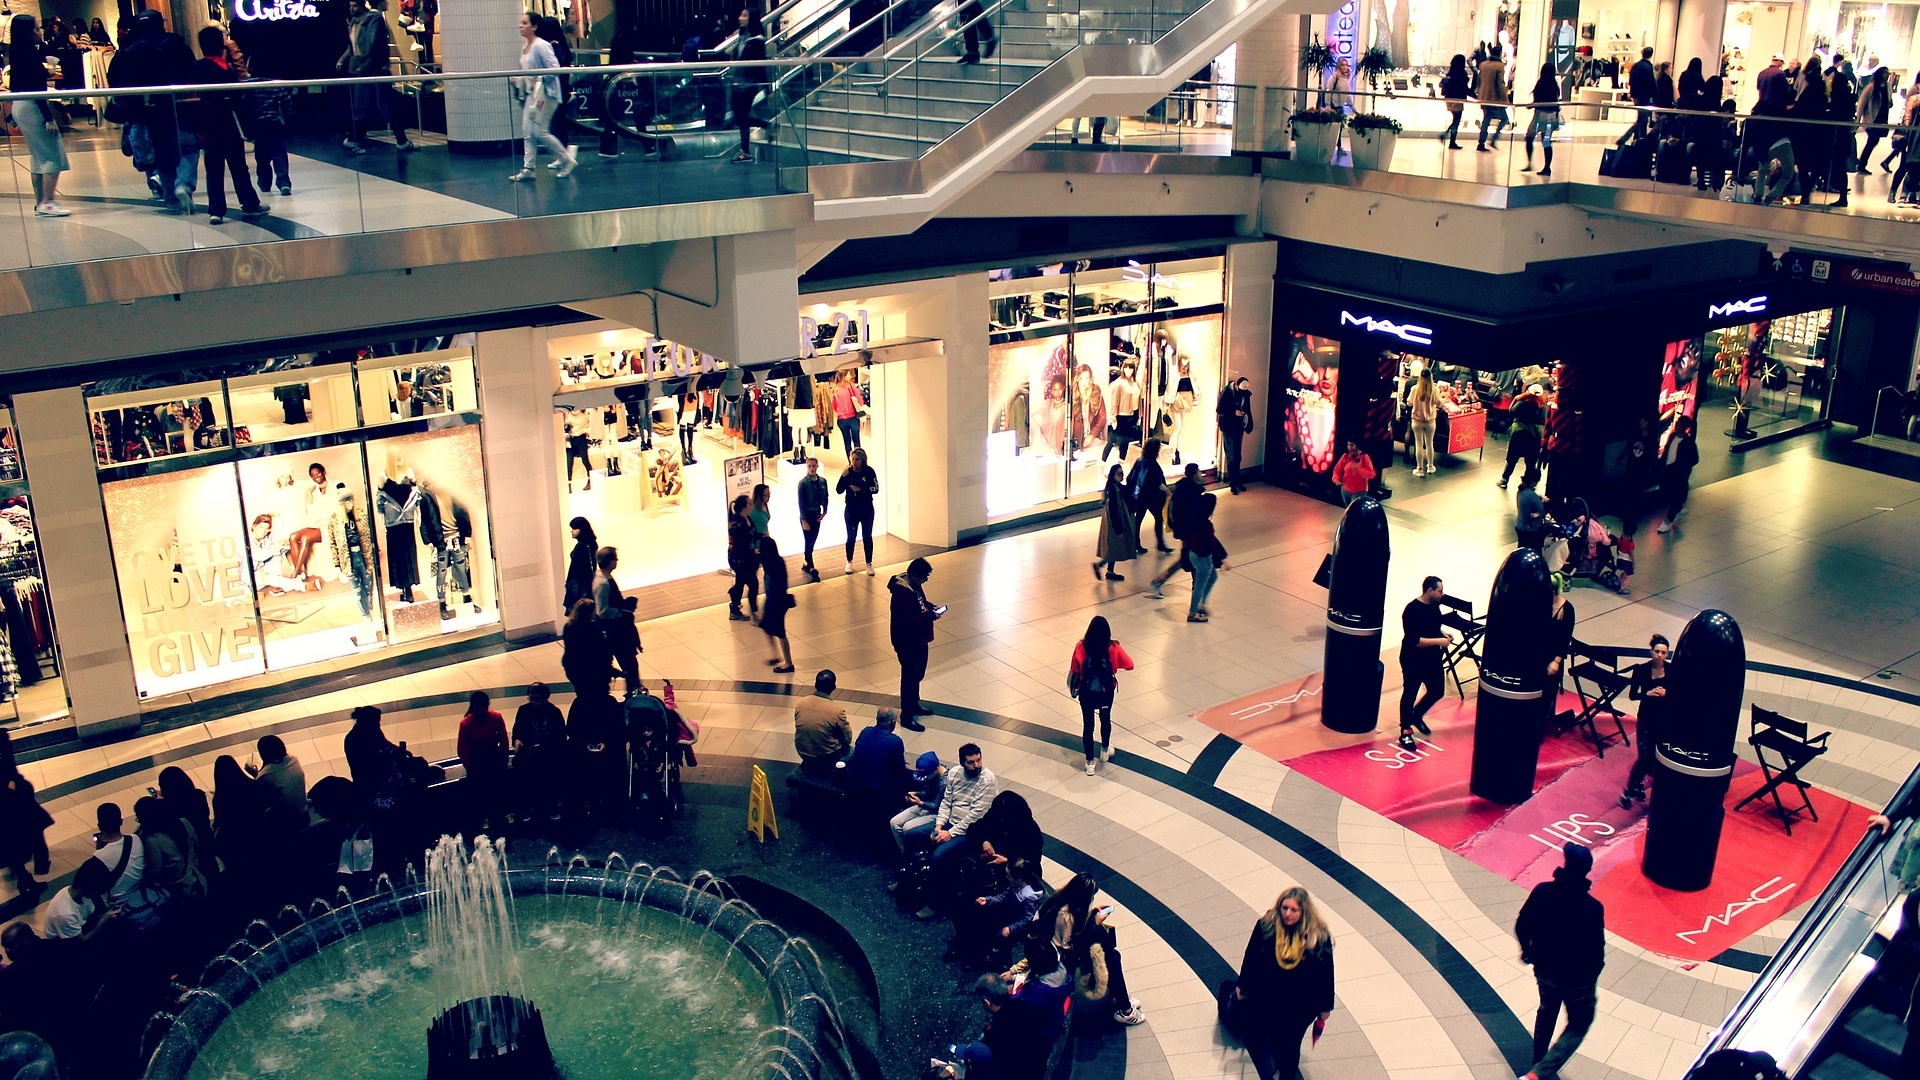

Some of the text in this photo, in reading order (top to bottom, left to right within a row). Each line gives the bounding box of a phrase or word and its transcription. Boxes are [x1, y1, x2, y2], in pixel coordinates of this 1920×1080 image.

[579, 95, 588, 110] 2
[618, 88, 639, 97] Level
[624, 98, 634, 114] 2
[1864, 272, 1893, 284] urban
[1708, 295, 1767, 319] MAC
[830, 309, 868, 355] 21
[1340, 310, 1433, 345] MAC
[132, 535, 237, 576] GVE TO
[137, 561, 245, 615] LOVE
[148, 621, 254, 677] GIVE
